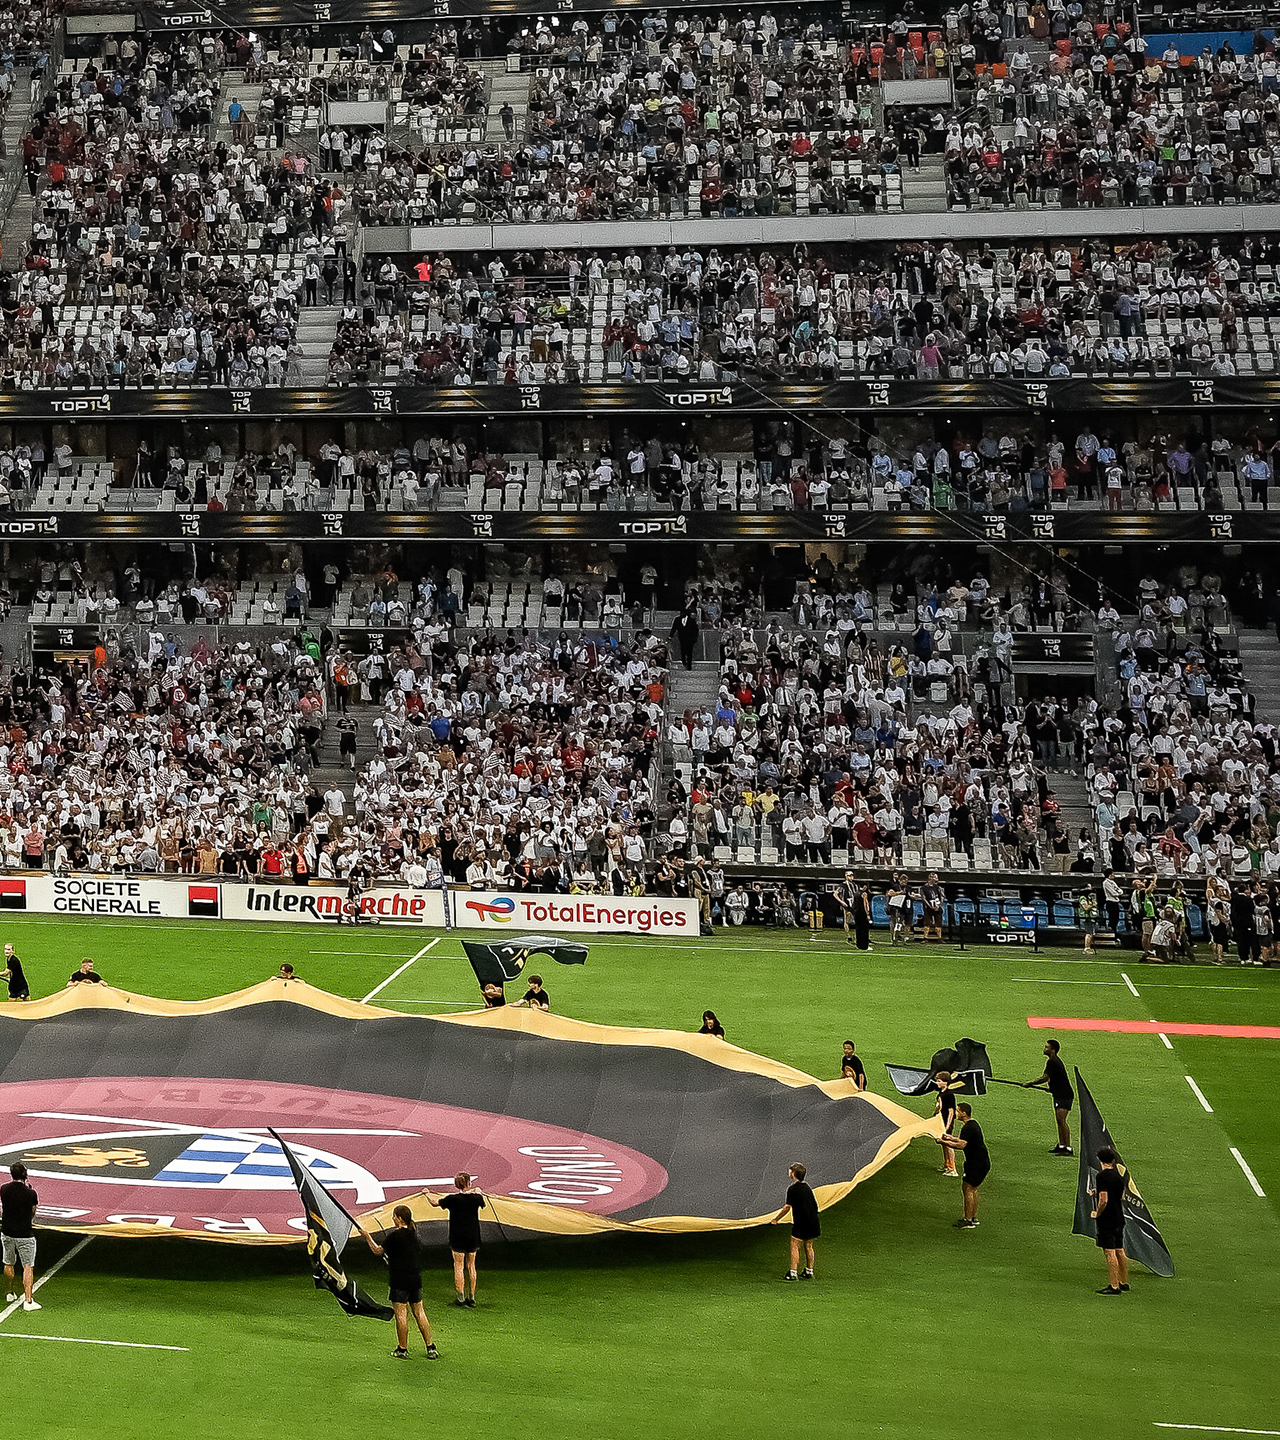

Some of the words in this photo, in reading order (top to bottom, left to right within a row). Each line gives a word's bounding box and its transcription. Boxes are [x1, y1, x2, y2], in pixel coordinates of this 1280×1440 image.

[161, 14, 211, 25] TOP14
[665, 393, 732, 404] TOP14
[51, 399, 110, 411] TOP14
[1030, 515, 1054, 523] TOP
[619, 521, 686, 533] TOP14
[54, 880, 140, 896] SOCIETE
[54, 897, 160, 914] GENERALE
[520, 900, 687, 931] TotalEnergies
[987, 933, 1035, 943] TOP14
